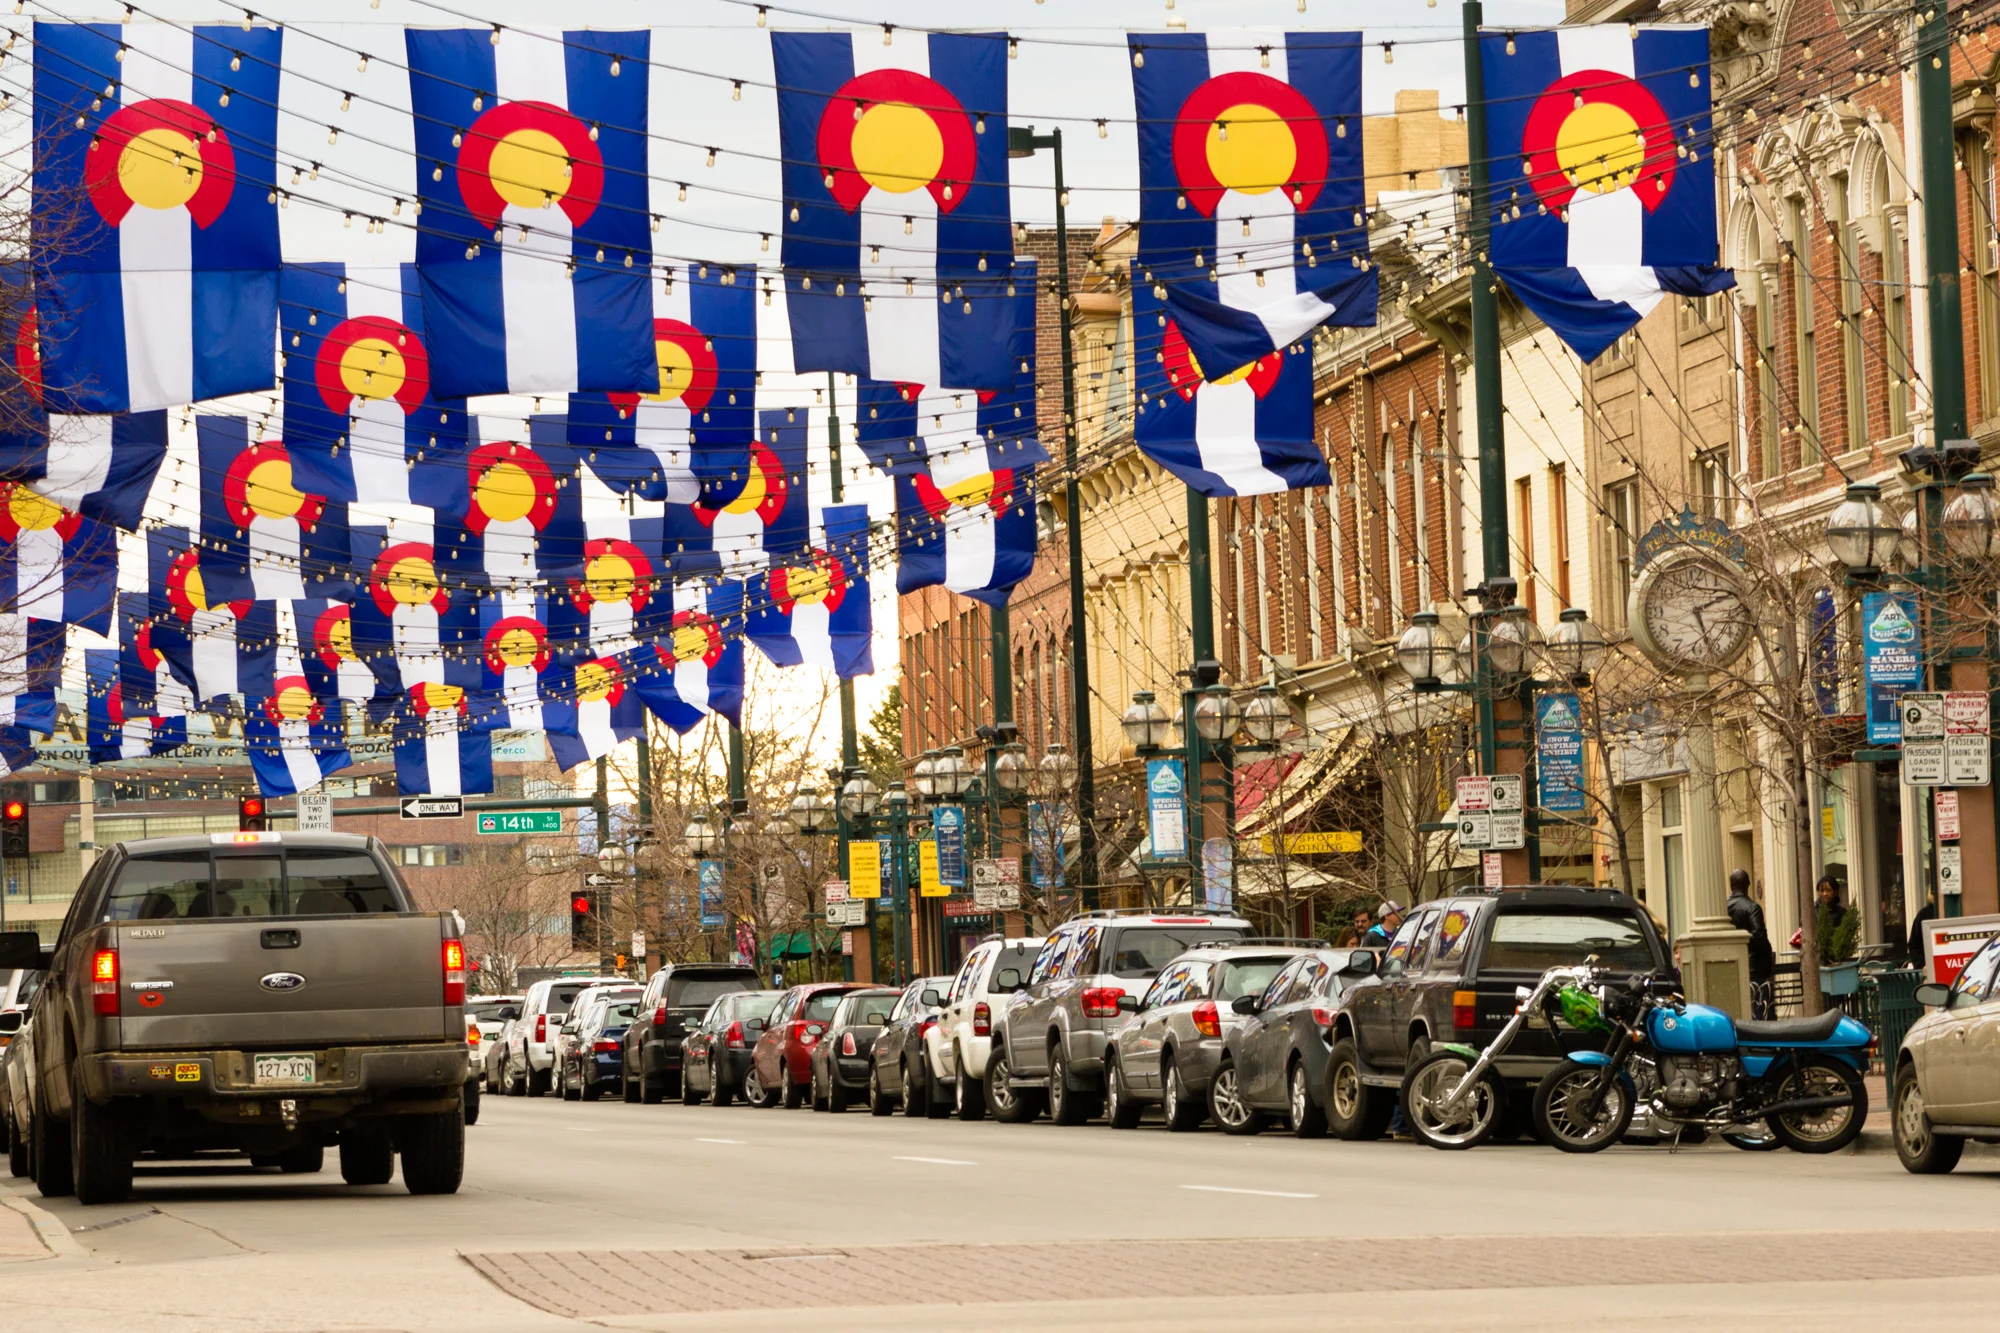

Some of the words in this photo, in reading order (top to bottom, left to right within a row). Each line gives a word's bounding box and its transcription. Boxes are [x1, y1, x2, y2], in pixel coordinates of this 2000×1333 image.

[1884, 613, 1901, 621] ART
[1879, 647, 1907, 656] FILM
[1870, 655, 1917, 664] MAKERS
[1869, 664, 1918, 673] PROJECT
[1540, 742, 1580, 750] INSPIRED
[302, 796, 328, 805] BEGIN
[419, 804, 436, 813] ONE
[438, 803, 457, 812] WAY
[1939, 805, 1956, 813] Valet
[307, 814, 323, 822] WAY
[301, 822, 330, 830] TRAFFIC
[501, 816, 534, 830] 14th
[1299, 833, 1343, 843] SHOPS
[1298, 844, 1344, 852] DINING
[1944, 932, 1984, 942] LARIMER
[270, 977, 295, 987] Ford
